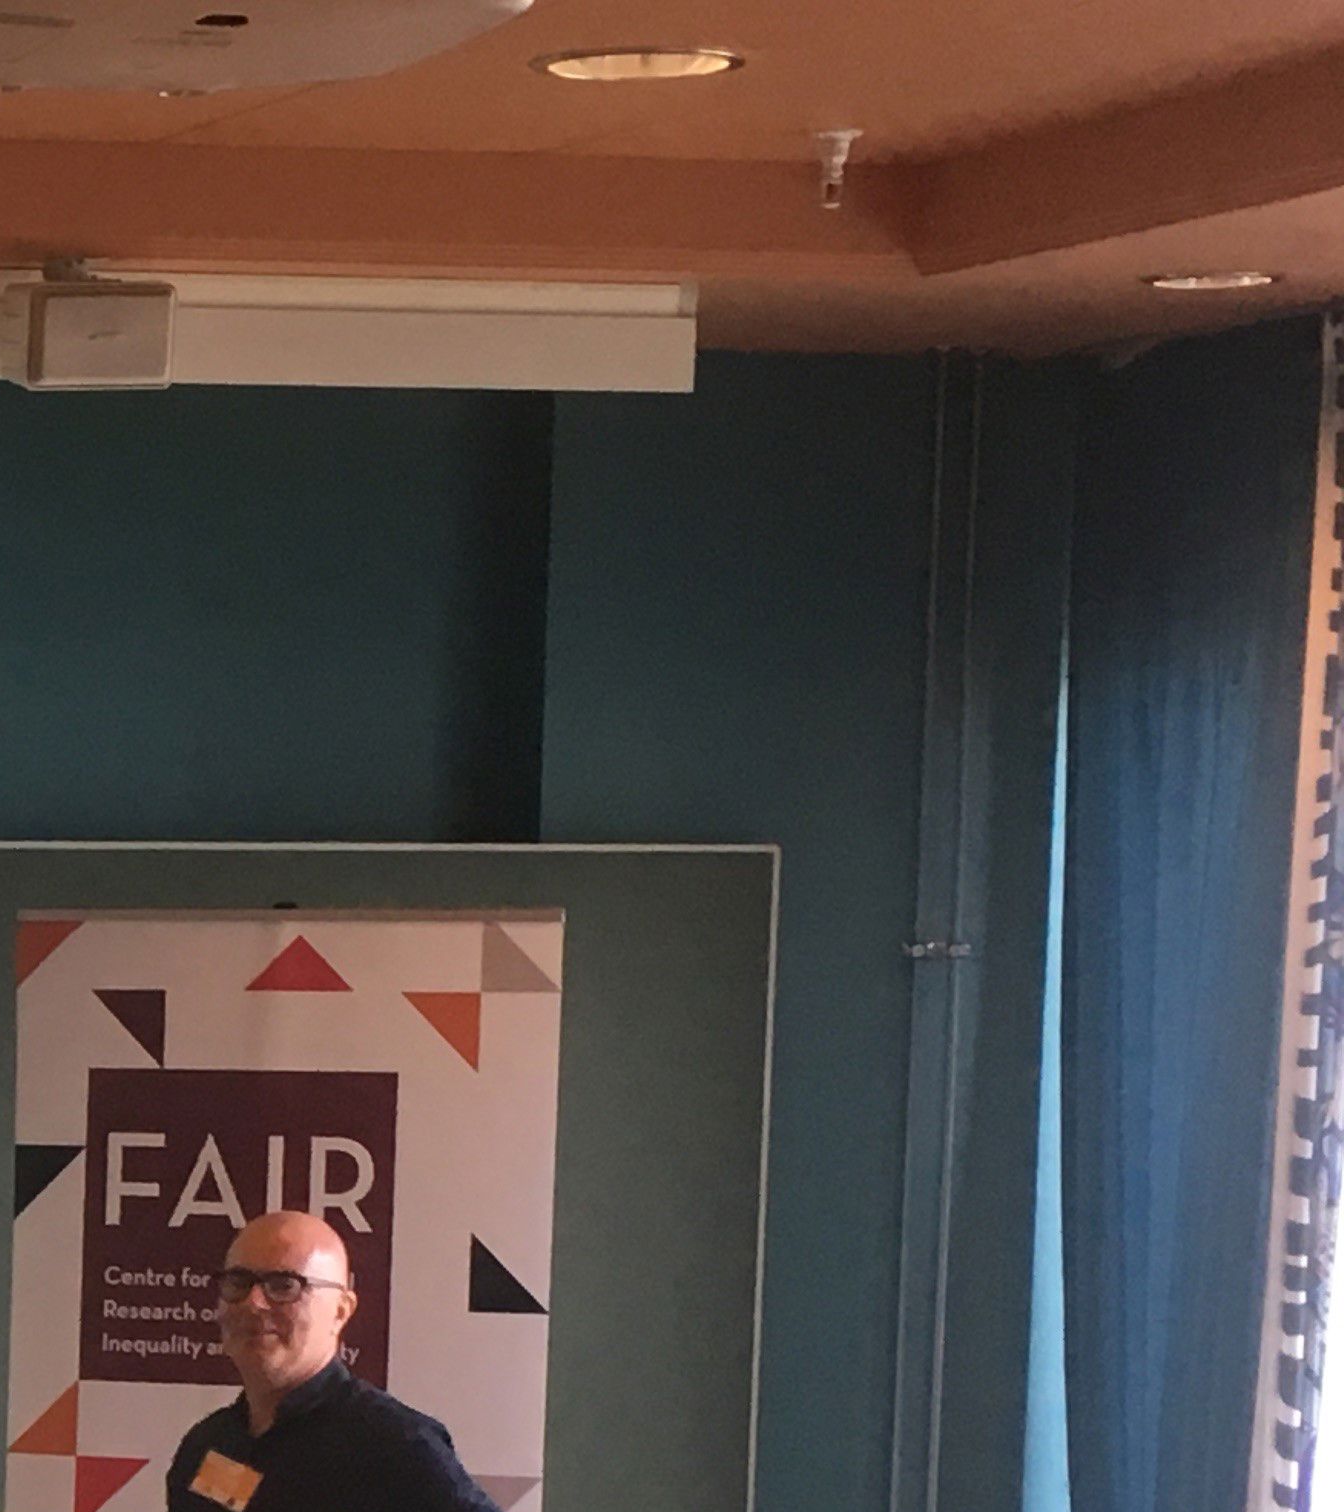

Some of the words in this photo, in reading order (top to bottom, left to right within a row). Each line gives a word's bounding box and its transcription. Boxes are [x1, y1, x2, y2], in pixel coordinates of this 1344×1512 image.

[105, 1131, 376, 1234] FAIR
[103, 1266, 176, 1288] Centre
[181, 1267, 212, 1289] for
[103, 1298, 196, 1321] Research
[101, 1333, 204, 1360] Inequality
